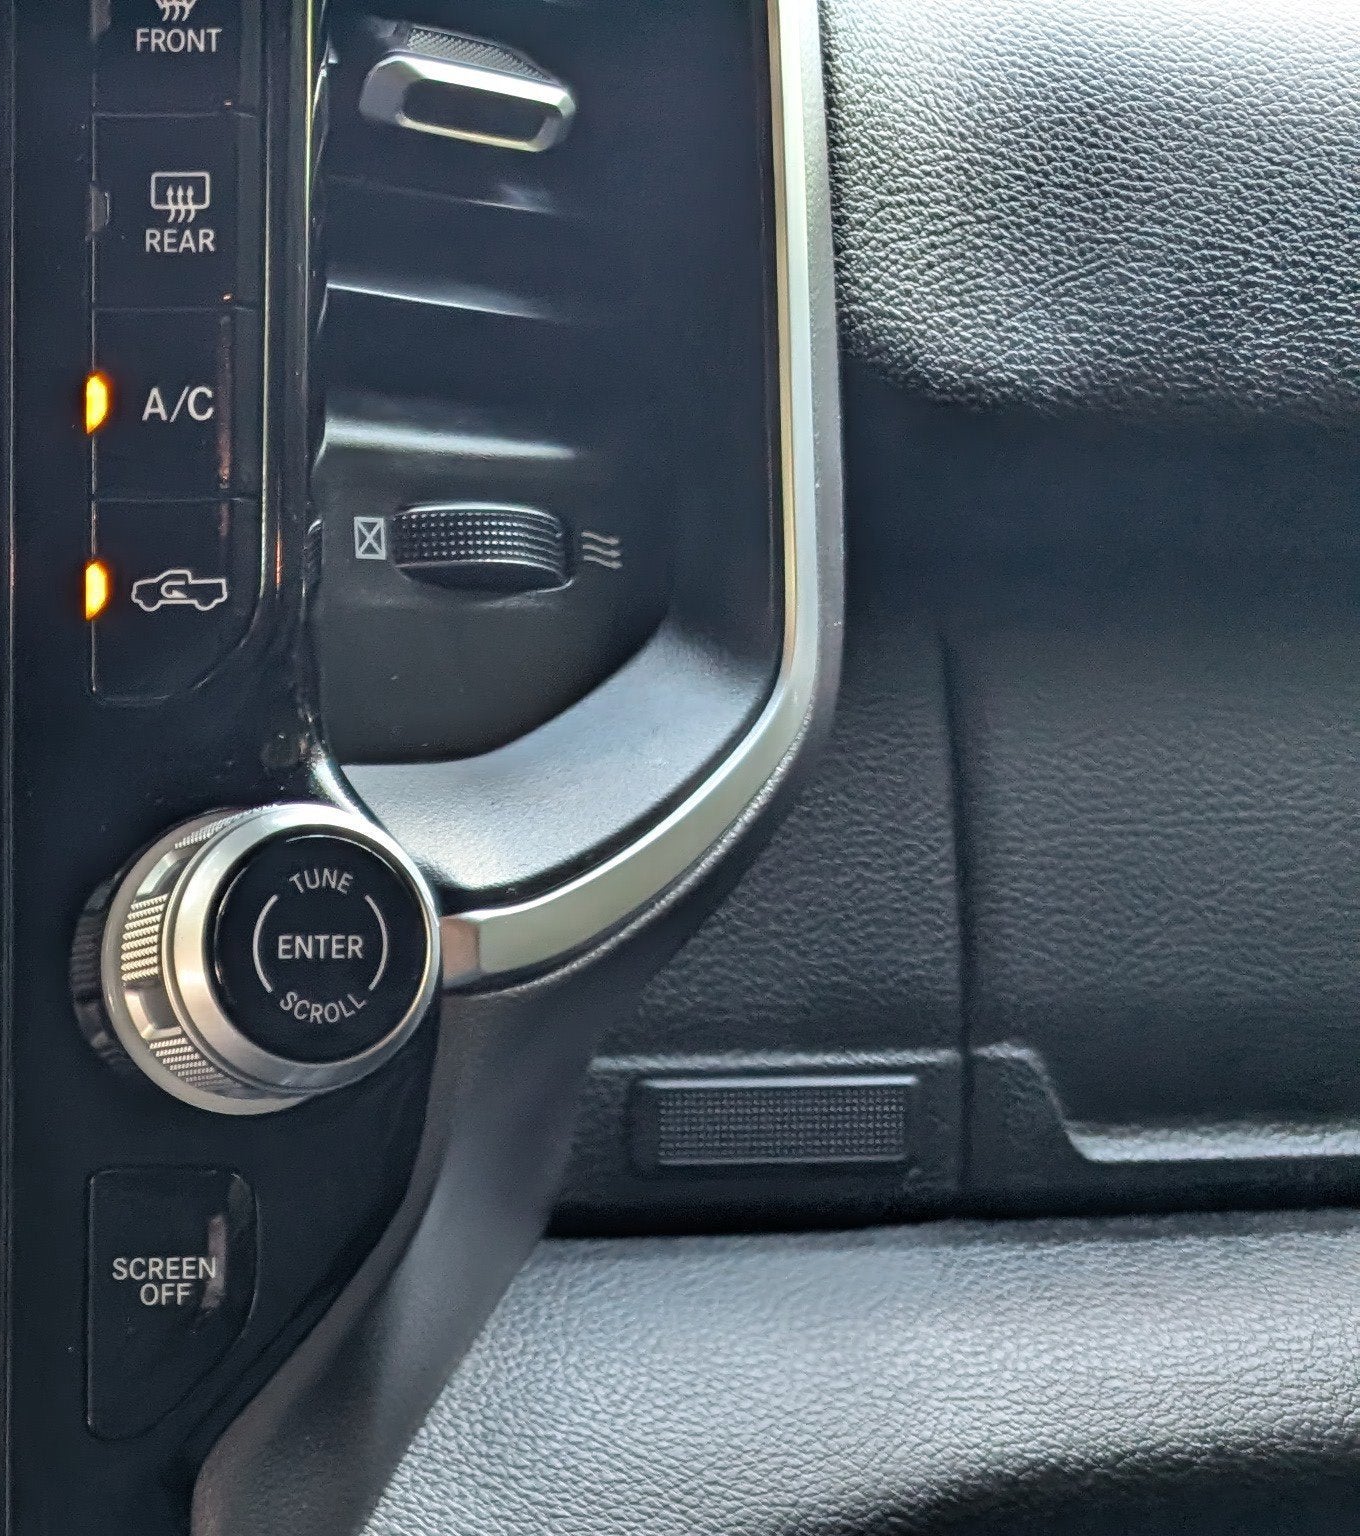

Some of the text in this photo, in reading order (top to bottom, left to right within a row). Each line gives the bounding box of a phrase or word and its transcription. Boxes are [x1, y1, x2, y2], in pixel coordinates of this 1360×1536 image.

[135, 28, 223, 53] FRONT
[145, 228, 216, 254] REAR
[141, 386, 214, 423] A/C
[288, 866, 354, 896] TUNE
[277, 934, 364, 960] ENTER
[280, 990, 368, 1025] SCROLL
[111, 1256, 217, 1281] SCREEN
[139, 1282, 193, 1306] OFF
